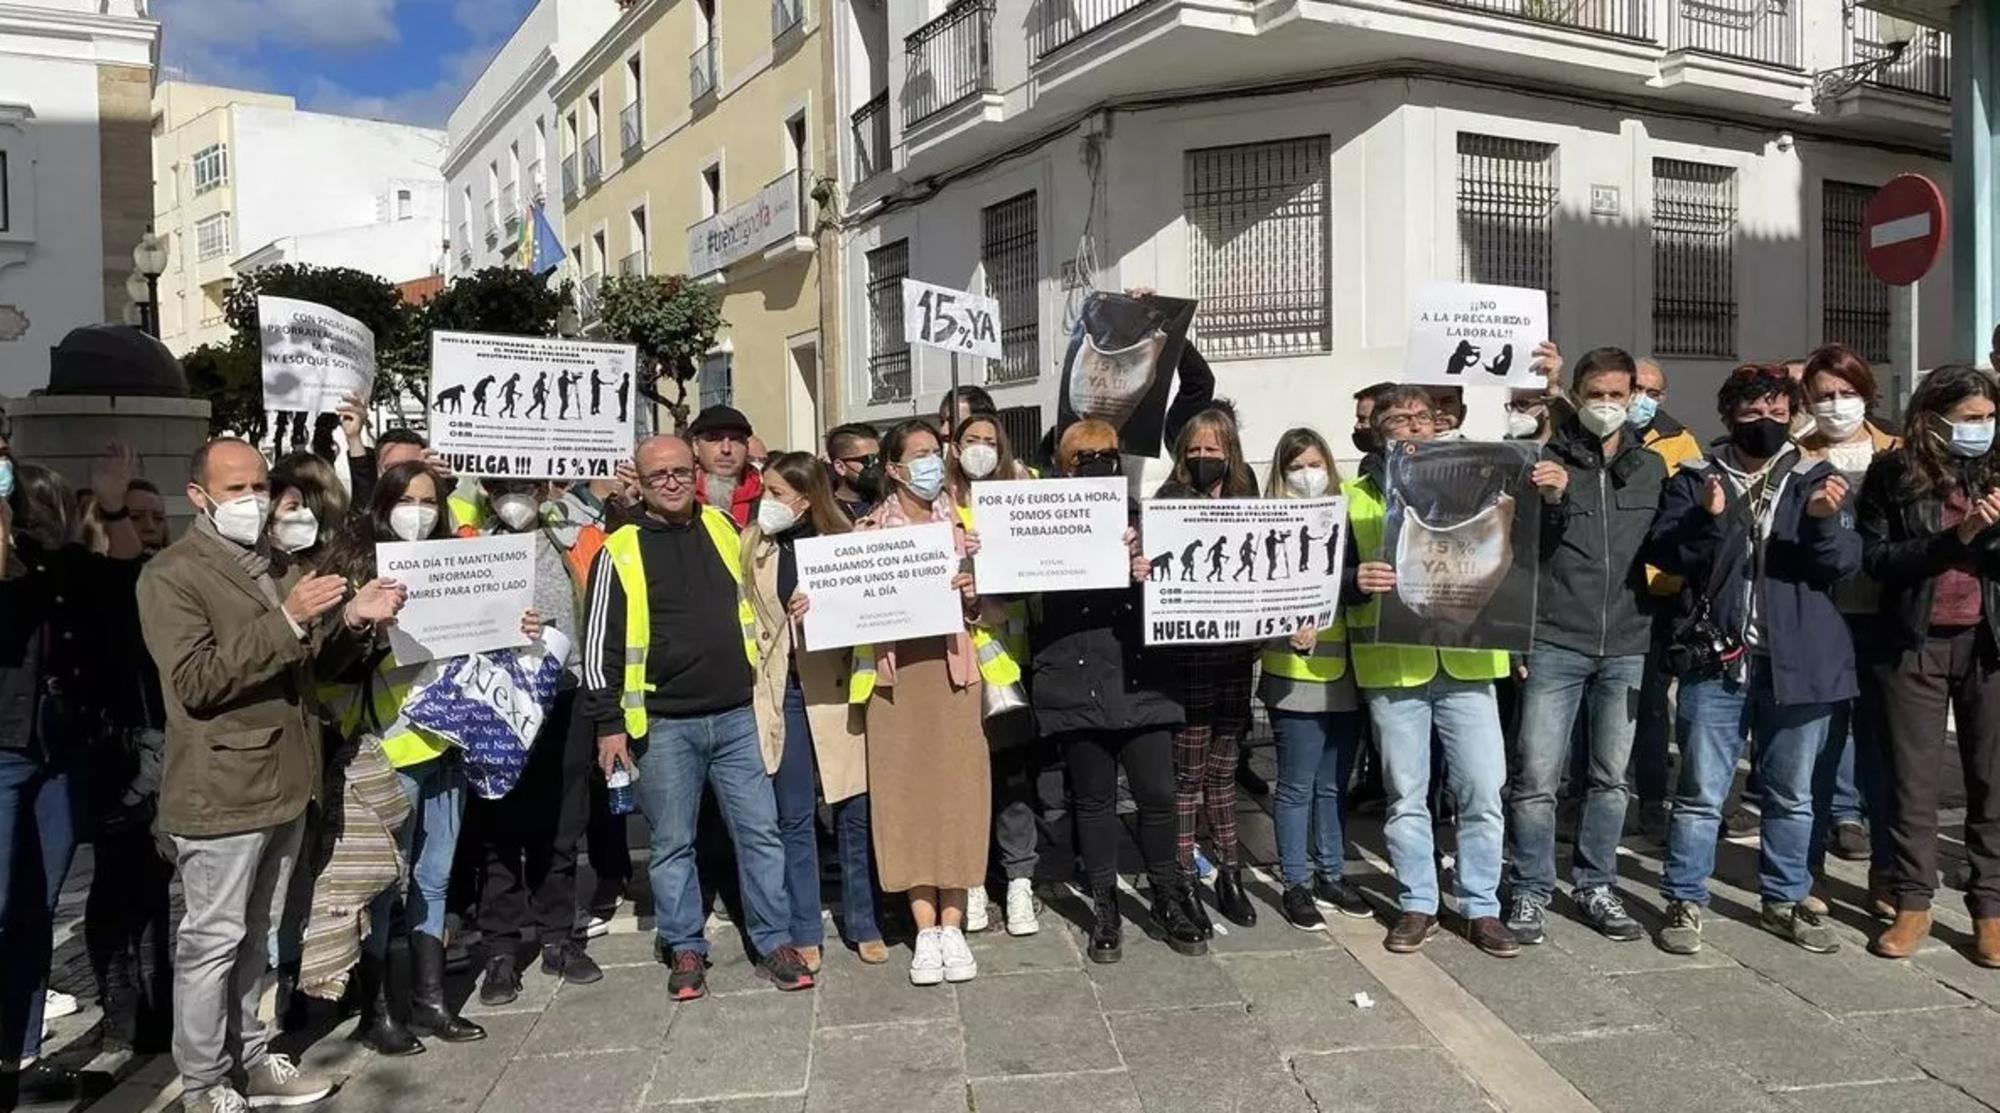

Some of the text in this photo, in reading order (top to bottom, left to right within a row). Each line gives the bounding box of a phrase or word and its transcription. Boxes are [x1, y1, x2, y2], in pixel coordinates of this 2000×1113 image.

[965, 307, 996, 343] YA
[1421, 312, 1429, 322] A
[1434, 312, 1449, 322] LA
[1446, 327, 1513, 339] LABORAL!!
[283, 354, 304, 365] ESO
[306, 355, 329, 367] QUE
[515, 456, 532, 474] !!!
[587, 459, 609, 476] YA
[979, 491, 1121, 506] POR 4/6 EUROS LA HORA,
[1009, 508, 1091, 522] SOMOS GENTE
[1010, 524, 1093, 537] TRABAJADORA
[834, 539, 916, 558] CADA JORNADA
[389, 551, 528, 571] CADA DÍA TE MANTENEMOS
[804, 549, 949, 576] TRABAJAMOS CON ALEGRÍA,
[1422, 560, 1449, 574] YA
[429, 568, 494, 583] INFORMADO,
[809, 564, 948, 590] PERO POR UNOS 40 EUROS
[409, 579, 527, 600] MIRES PARA OTRO LADO
[863, 585, 898, 598] AL DÍA
[1152, 620, 1219, 641] HUELGA
[1224, 620, 1240, 638] !!!
[465, 656, 535, 740] Next
